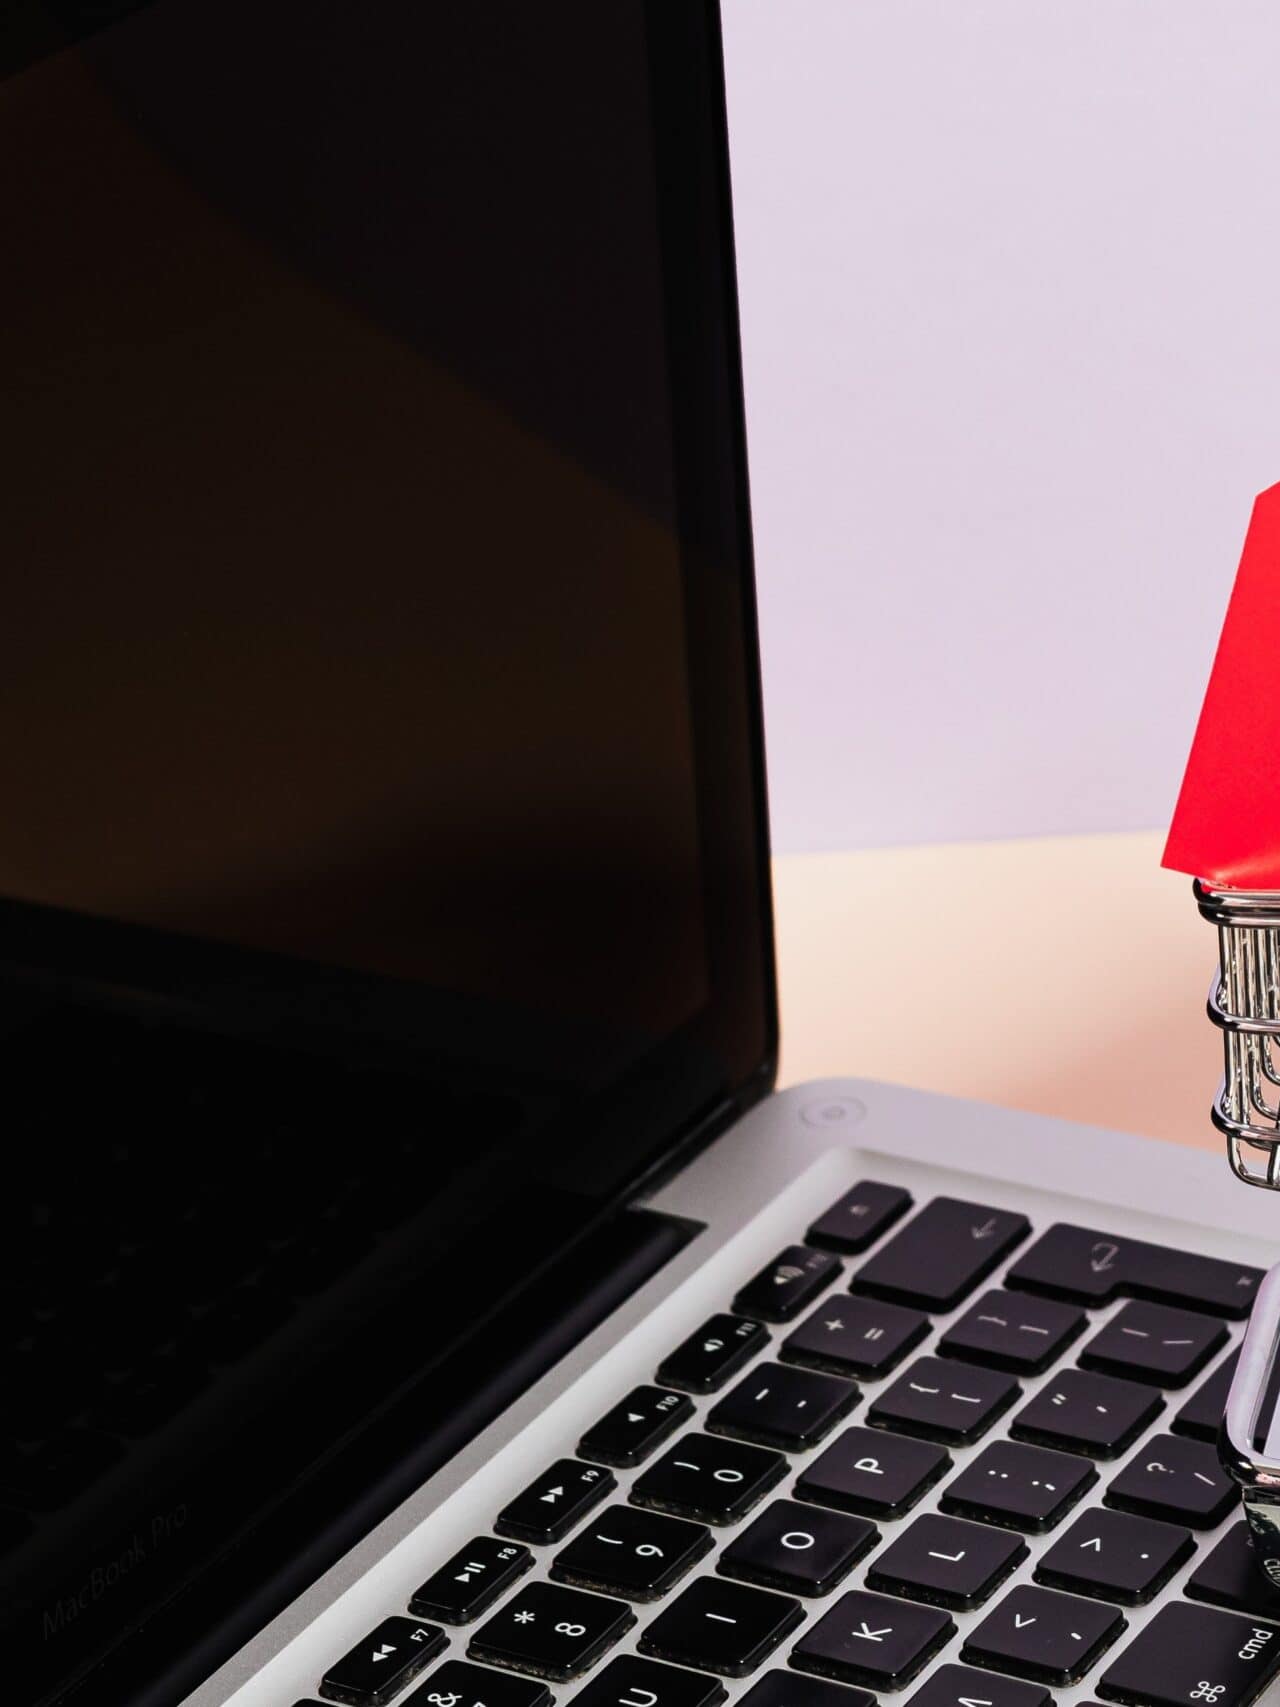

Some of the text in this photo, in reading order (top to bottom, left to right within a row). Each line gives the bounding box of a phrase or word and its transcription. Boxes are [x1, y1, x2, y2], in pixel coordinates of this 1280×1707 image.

[655, 1394, 681, 1412] F10
[853, 1457, 884, 1475] P
[1146, 1462, 1174, 1473] ?
[581, 1469, 601, 1483] F9
[780, 1531, 815, 1550] O
[497, 1546, 518, 1561] F8
[635, 1544, 664, 1558] 9
[928, 1551, 966, 1562] L
[42, 1503, 188, 1641] MacBook Pro
[410, 1628, 430, 1643] F7
[554, 1622, 587, 1637] 8
[851, 1622, 893, 1642] K
[1238, 1627, 1274, 1661] cmd
[427, 1692, 463, 1707] &
[618, 1687, 658, 1707] U
